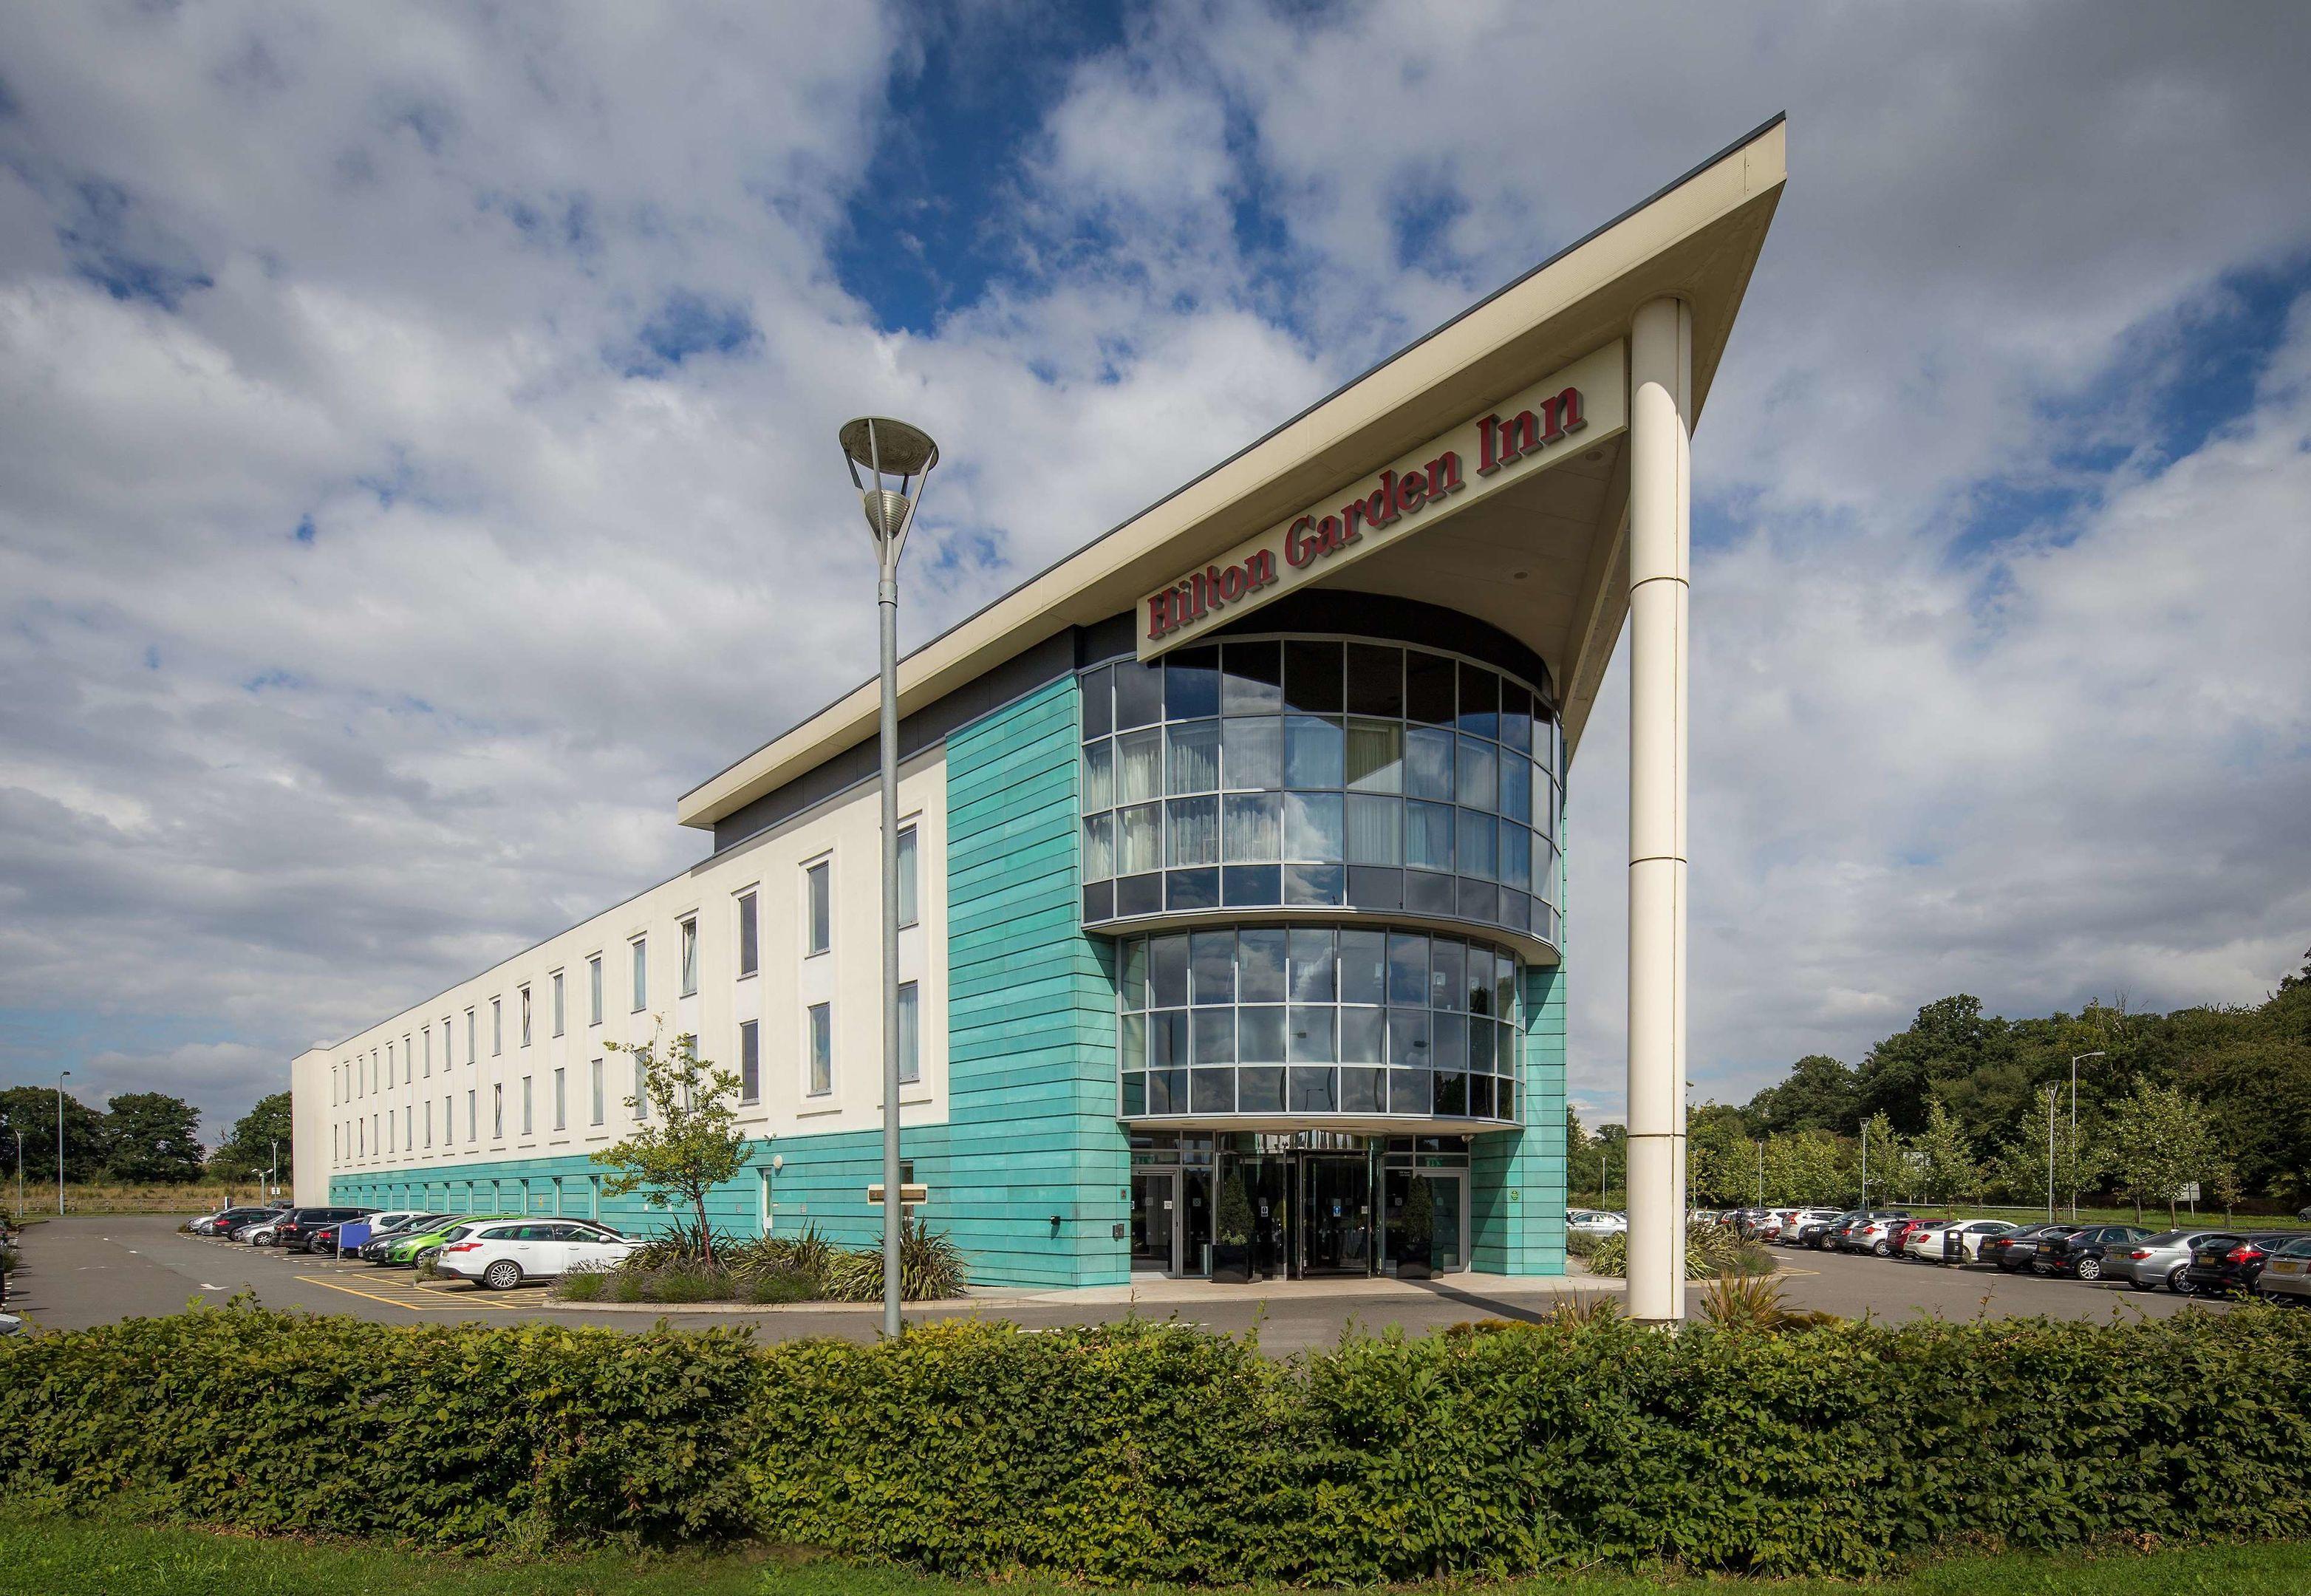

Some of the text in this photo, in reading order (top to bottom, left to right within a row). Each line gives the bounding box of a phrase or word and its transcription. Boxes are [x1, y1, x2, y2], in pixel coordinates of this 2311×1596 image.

[1147, 386, 1587, 640] Hilton Garden Inn
